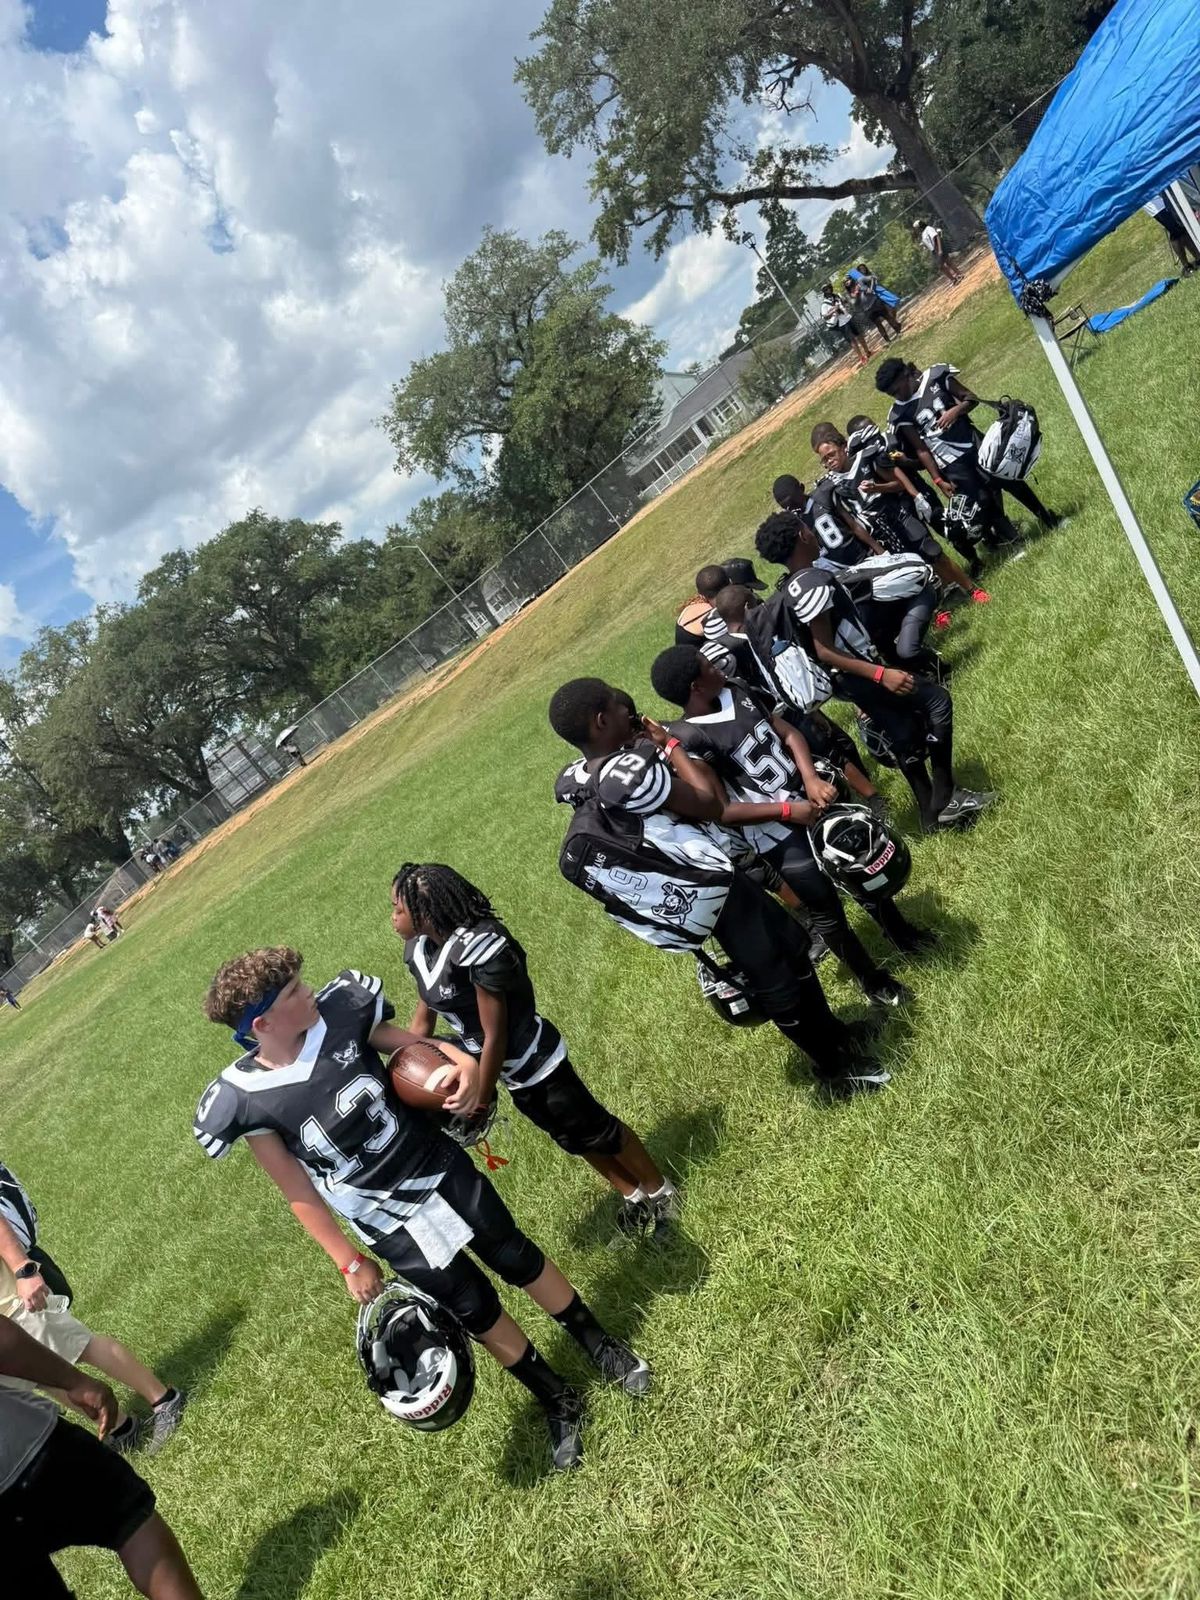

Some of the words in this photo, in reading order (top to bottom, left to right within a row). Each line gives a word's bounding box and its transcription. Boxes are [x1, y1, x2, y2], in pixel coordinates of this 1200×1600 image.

[609, 753, 646, 786] 19
[730, 718, 797, 794] 52
[867, 843, 895, 874] Riddell
[604, 867, 649, 906] 19
[300, 1073, 399, 1185] 13
[403, 1383, 453, 1419] Riddell
